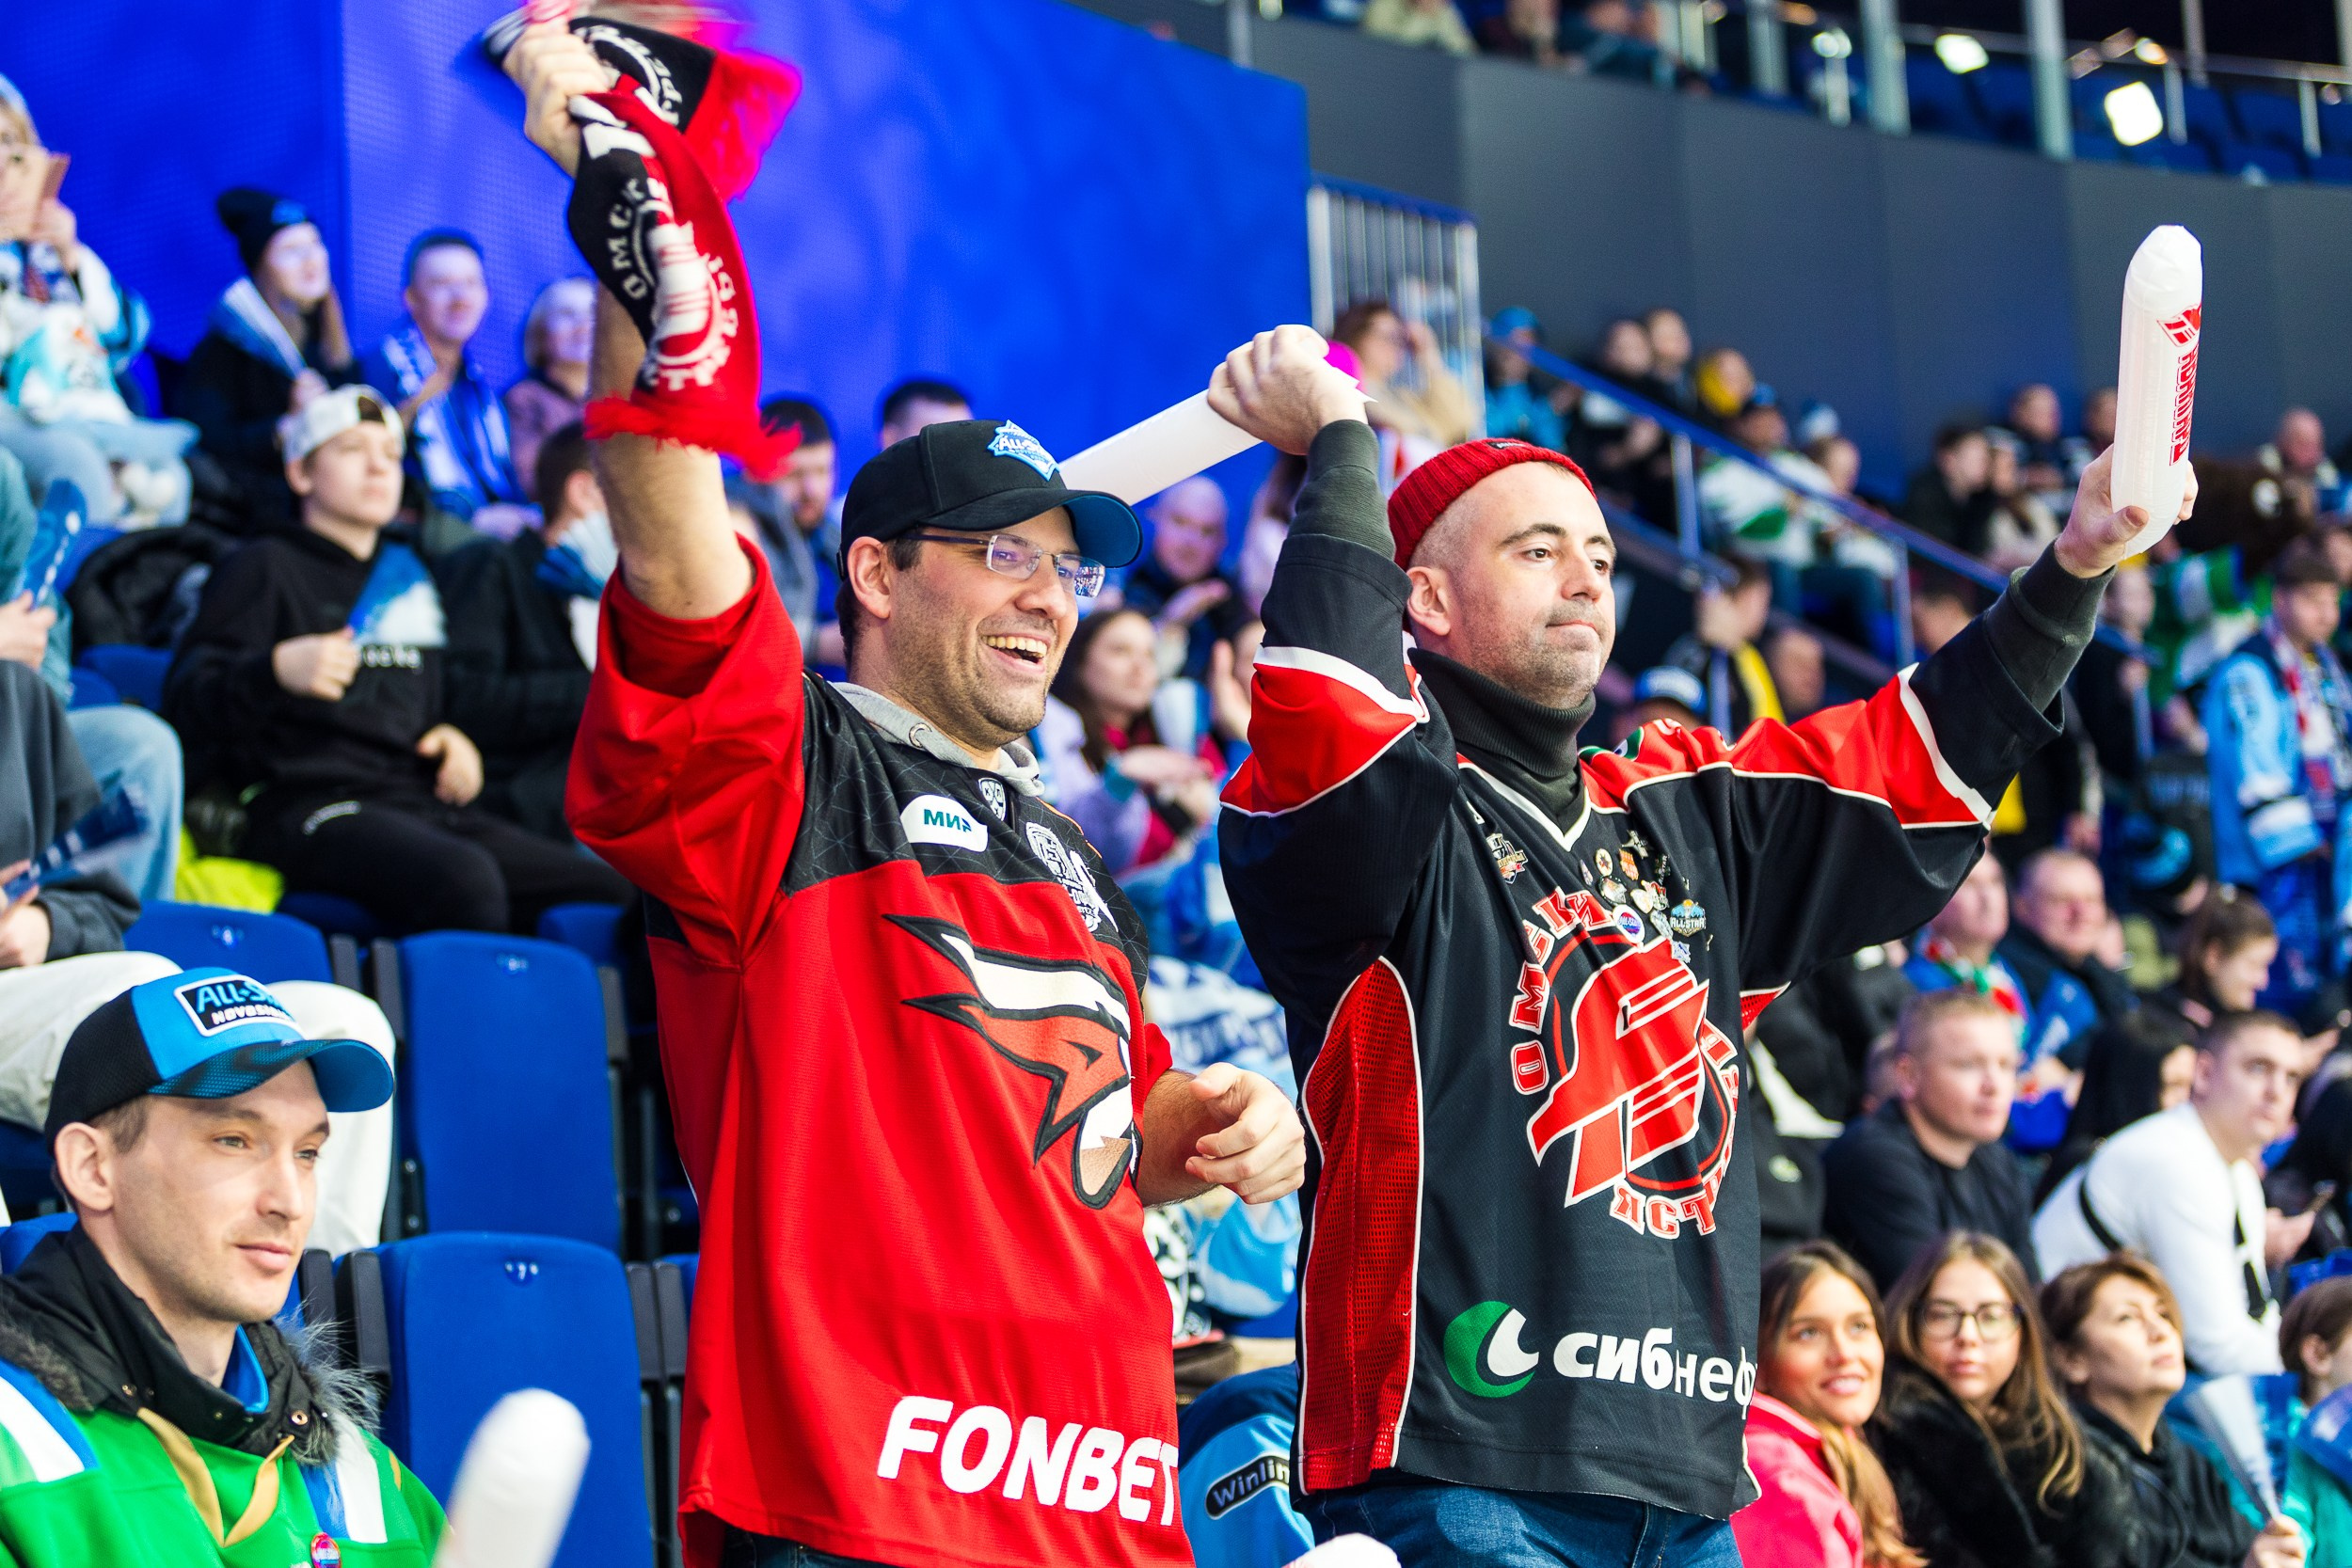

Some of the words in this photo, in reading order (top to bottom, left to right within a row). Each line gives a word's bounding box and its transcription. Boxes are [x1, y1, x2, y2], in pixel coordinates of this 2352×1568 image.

[1553, 1327, 1757, 1420] сибнеф
[877, 1395, 1179, 1527] FONBET
[1213, 1459, 1289, 1507] Winlin
